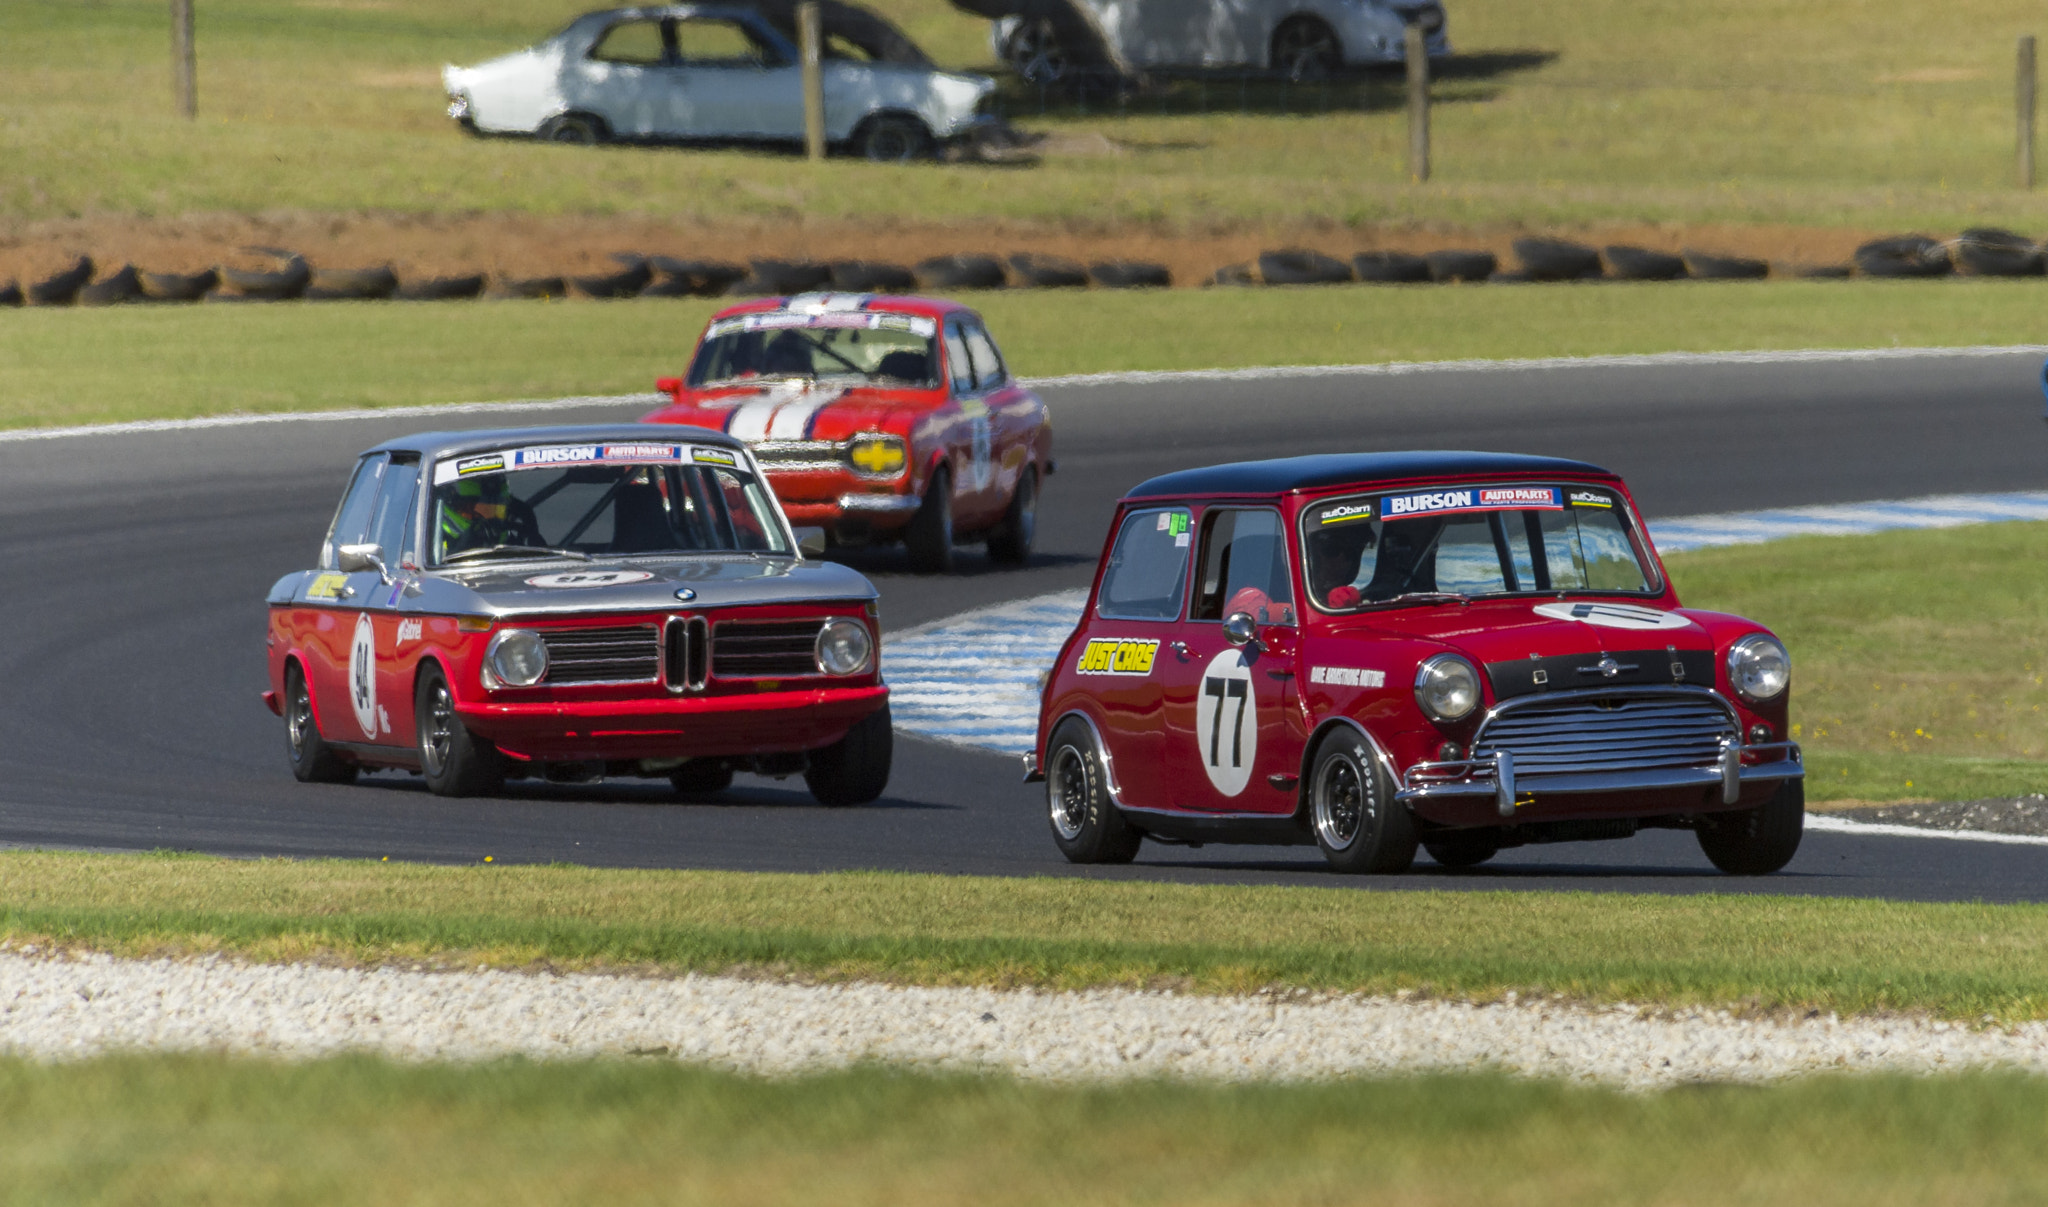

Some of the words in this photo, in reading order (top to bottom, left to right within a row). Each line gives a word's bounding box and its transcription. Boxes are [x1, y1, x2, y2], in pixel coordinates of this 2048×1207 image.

[523, 447, 597, 464] BURSON
[608, 447, 636, 456] AUTO
[637, 447, 670, 456] PARTS
[1391, 491, 1471, 513] BURSON
[1485, 490, 1515, 500] AUTO
[1516, 490, 1549, 499] PARTS
[1078, 640, 1119, 672] JUST
[1113, 641, 1158, 673] CARS
[1205, 676, 1248, 767] 77
